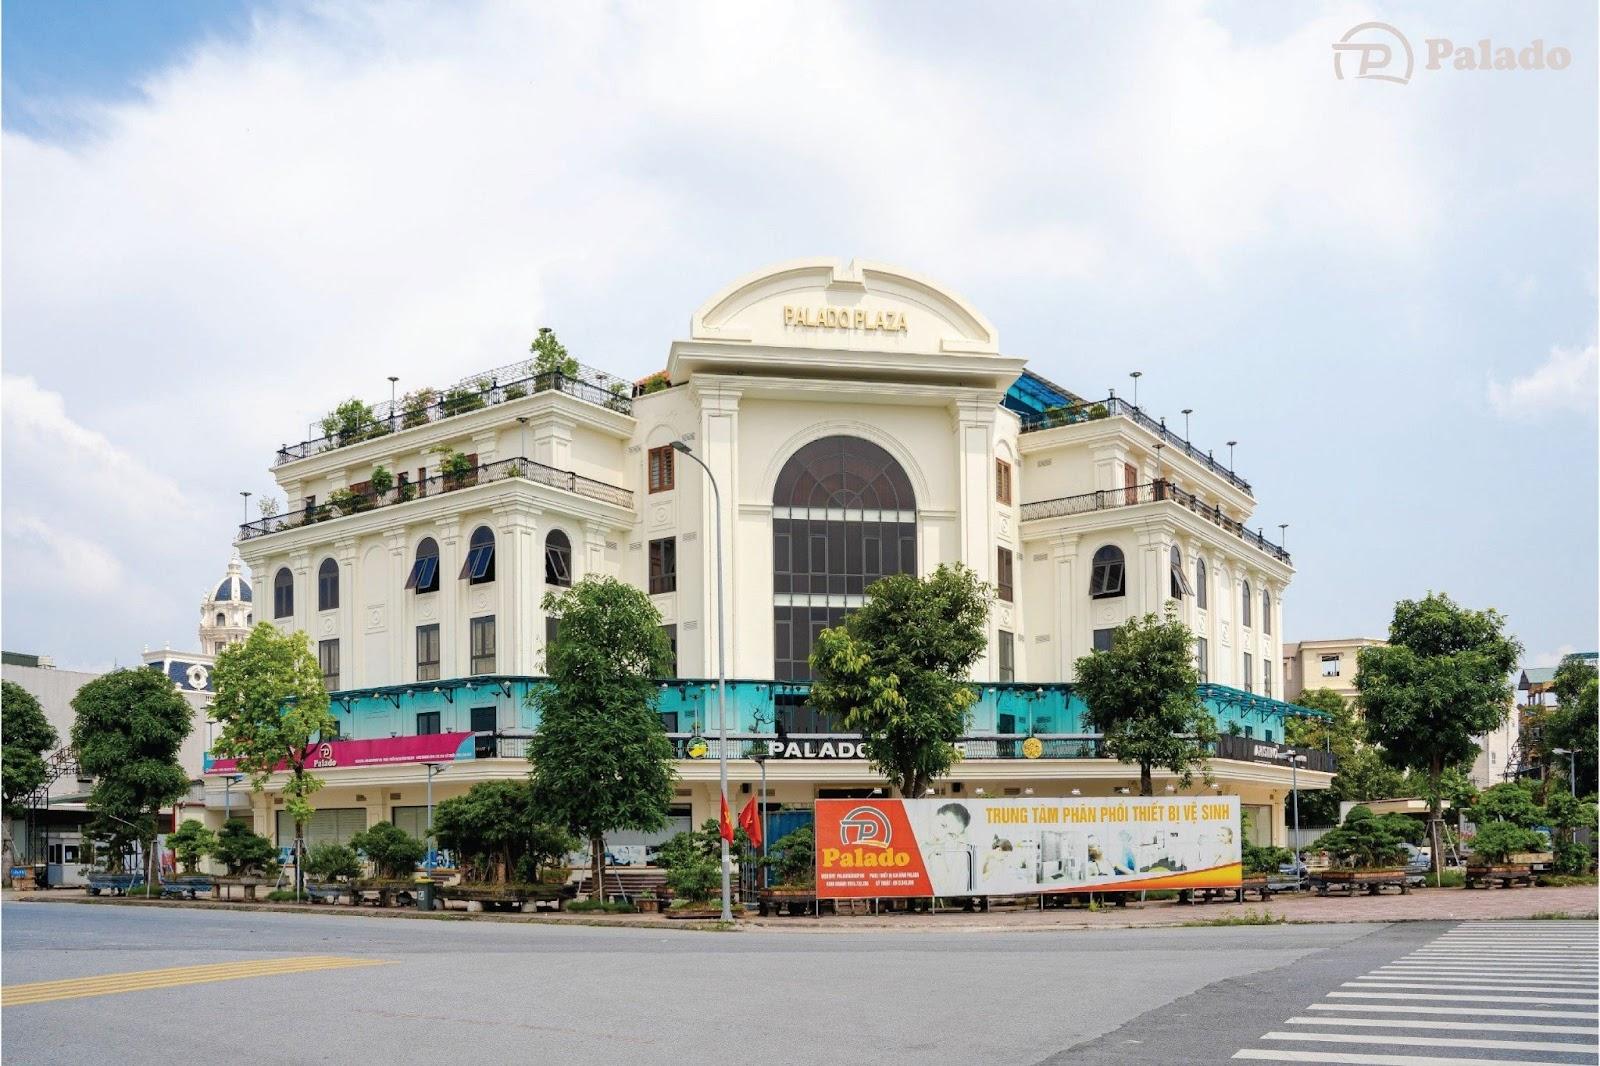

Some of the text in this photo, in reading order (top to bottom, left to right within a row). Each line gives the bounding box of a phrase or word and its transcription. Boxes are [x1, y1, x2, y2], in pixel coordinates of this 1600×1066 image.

[783, 305, 908, 333] PALADO PLAZA
[985, 800, 1231, 825] TRUNG TÂM PHÂN PHỐI THIẾT BỊ VỆ SINH
[822, 847, 910, 868] Palado
